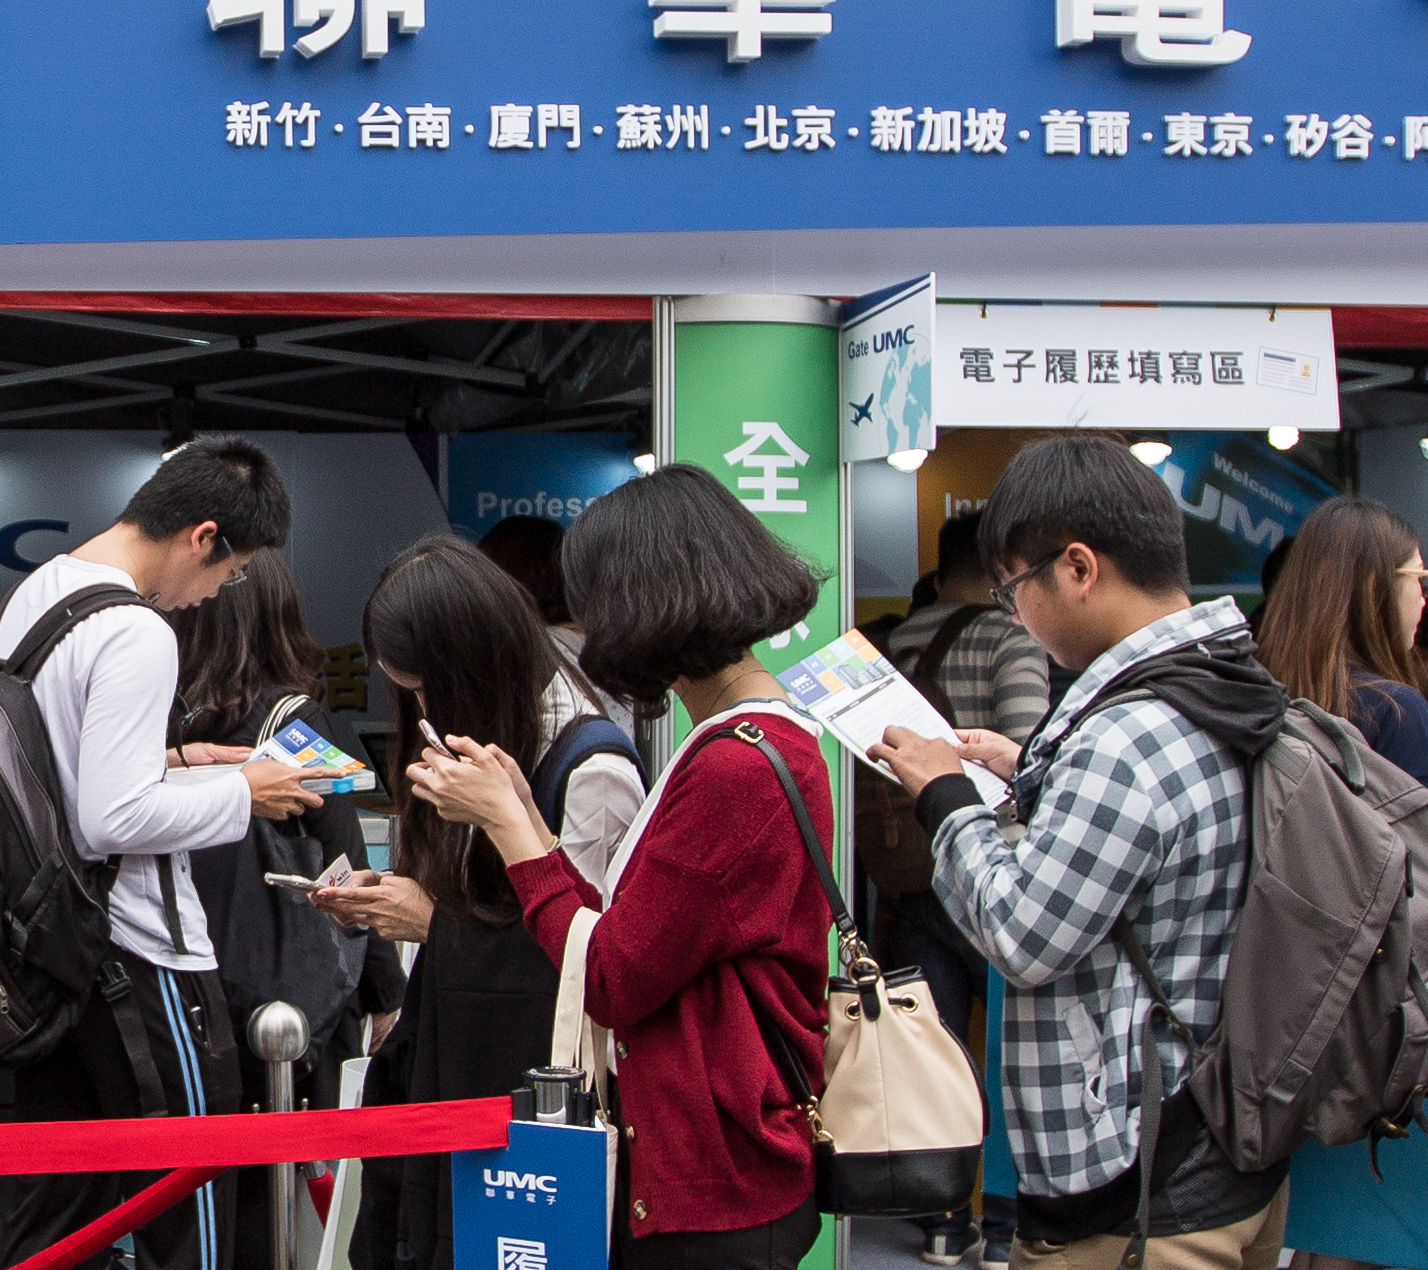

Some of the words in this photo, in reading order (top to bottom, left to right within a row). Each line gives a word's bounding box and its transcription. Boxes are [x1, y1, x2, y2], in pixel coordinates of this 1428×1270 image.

[848, 340, 870, 359] Gate
[873, 324, 915, 353] UMC
[960, 347, 1246, 385] 電子履歷填寫區
[1212, 451, 1295, 515] Welcome
[1162, 461, 1285, 552] UM
[483, 1168, 558, 1193] UMC
